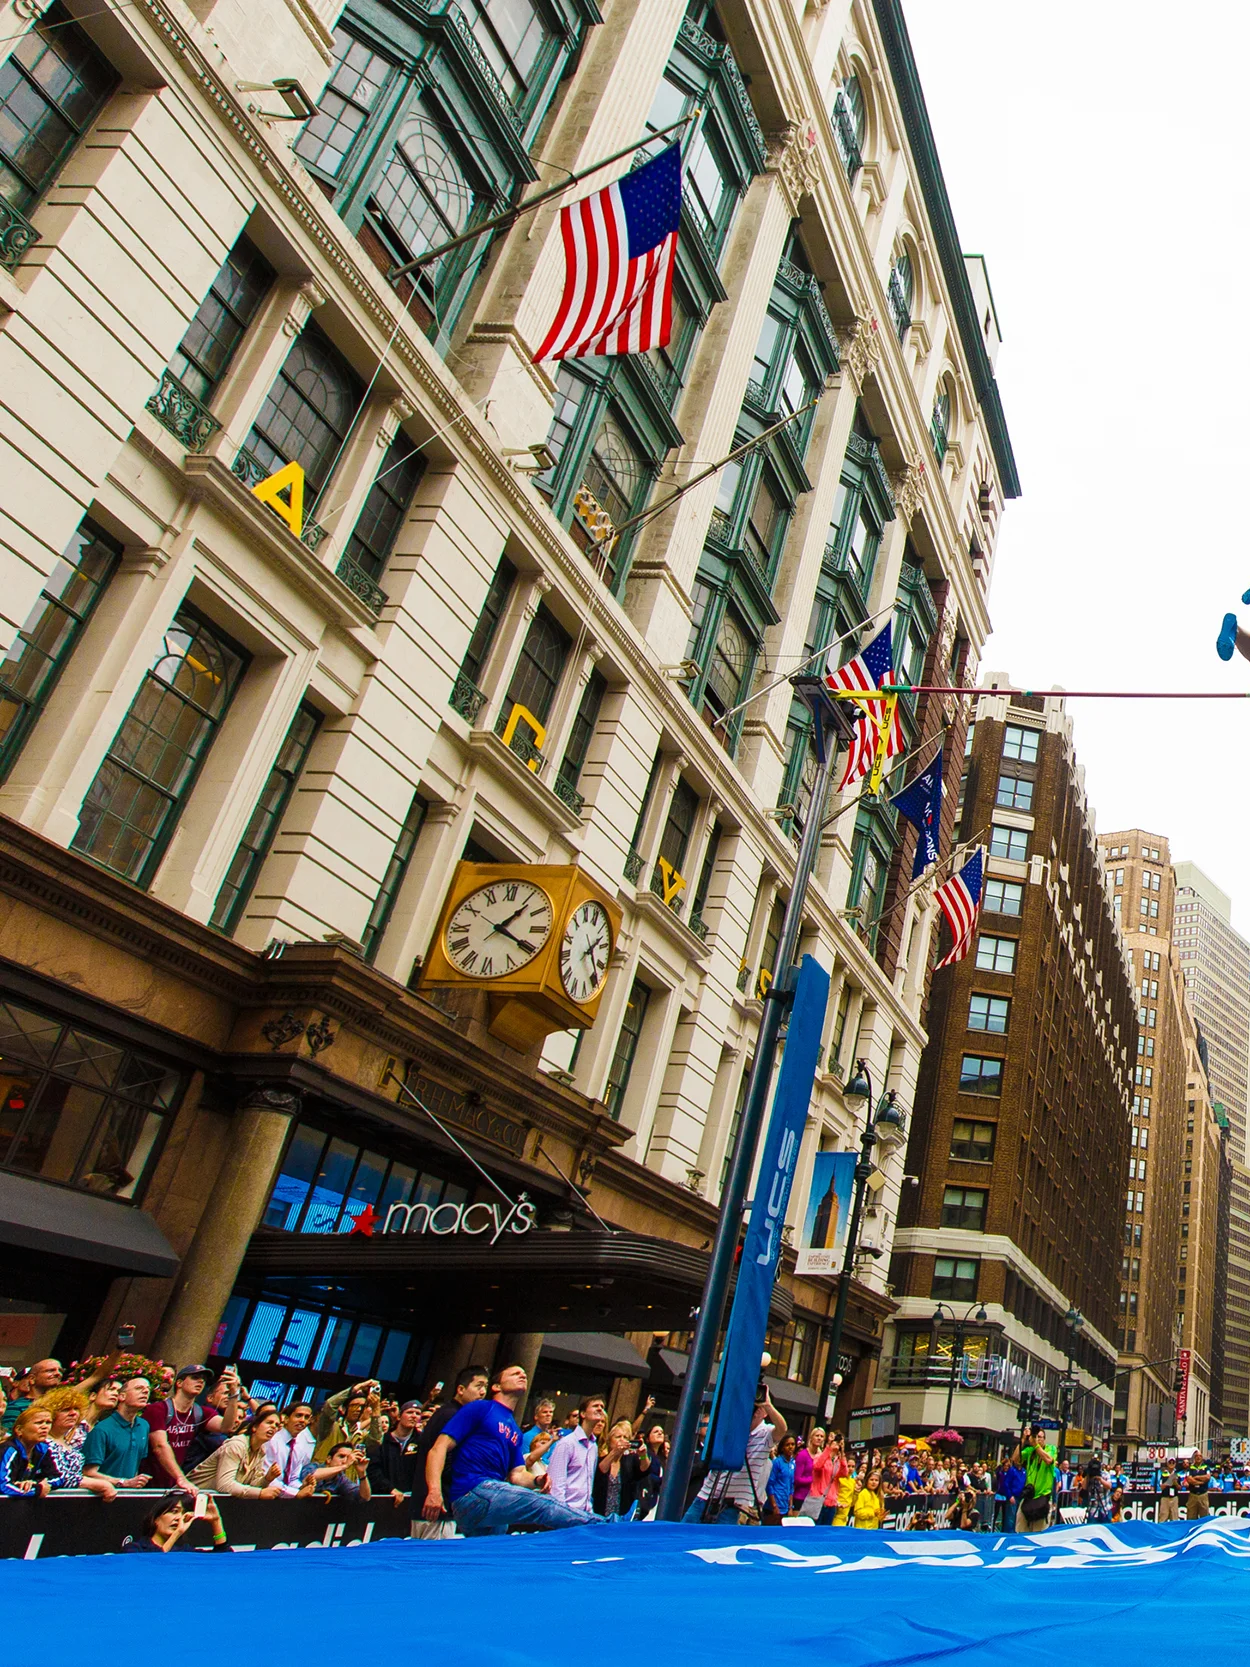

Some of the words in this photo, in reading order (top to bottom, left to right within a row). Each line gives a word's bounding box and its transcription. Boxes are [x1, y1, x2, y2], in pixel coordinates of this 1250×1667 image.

[251, 461, 305, 539] A
[883, 707, 892, 730] UCS
[872, 753, 883, 776] UCS
[449, 1096, 496, 1134] MACY
[757, 1128, 796, 1266] UCS
